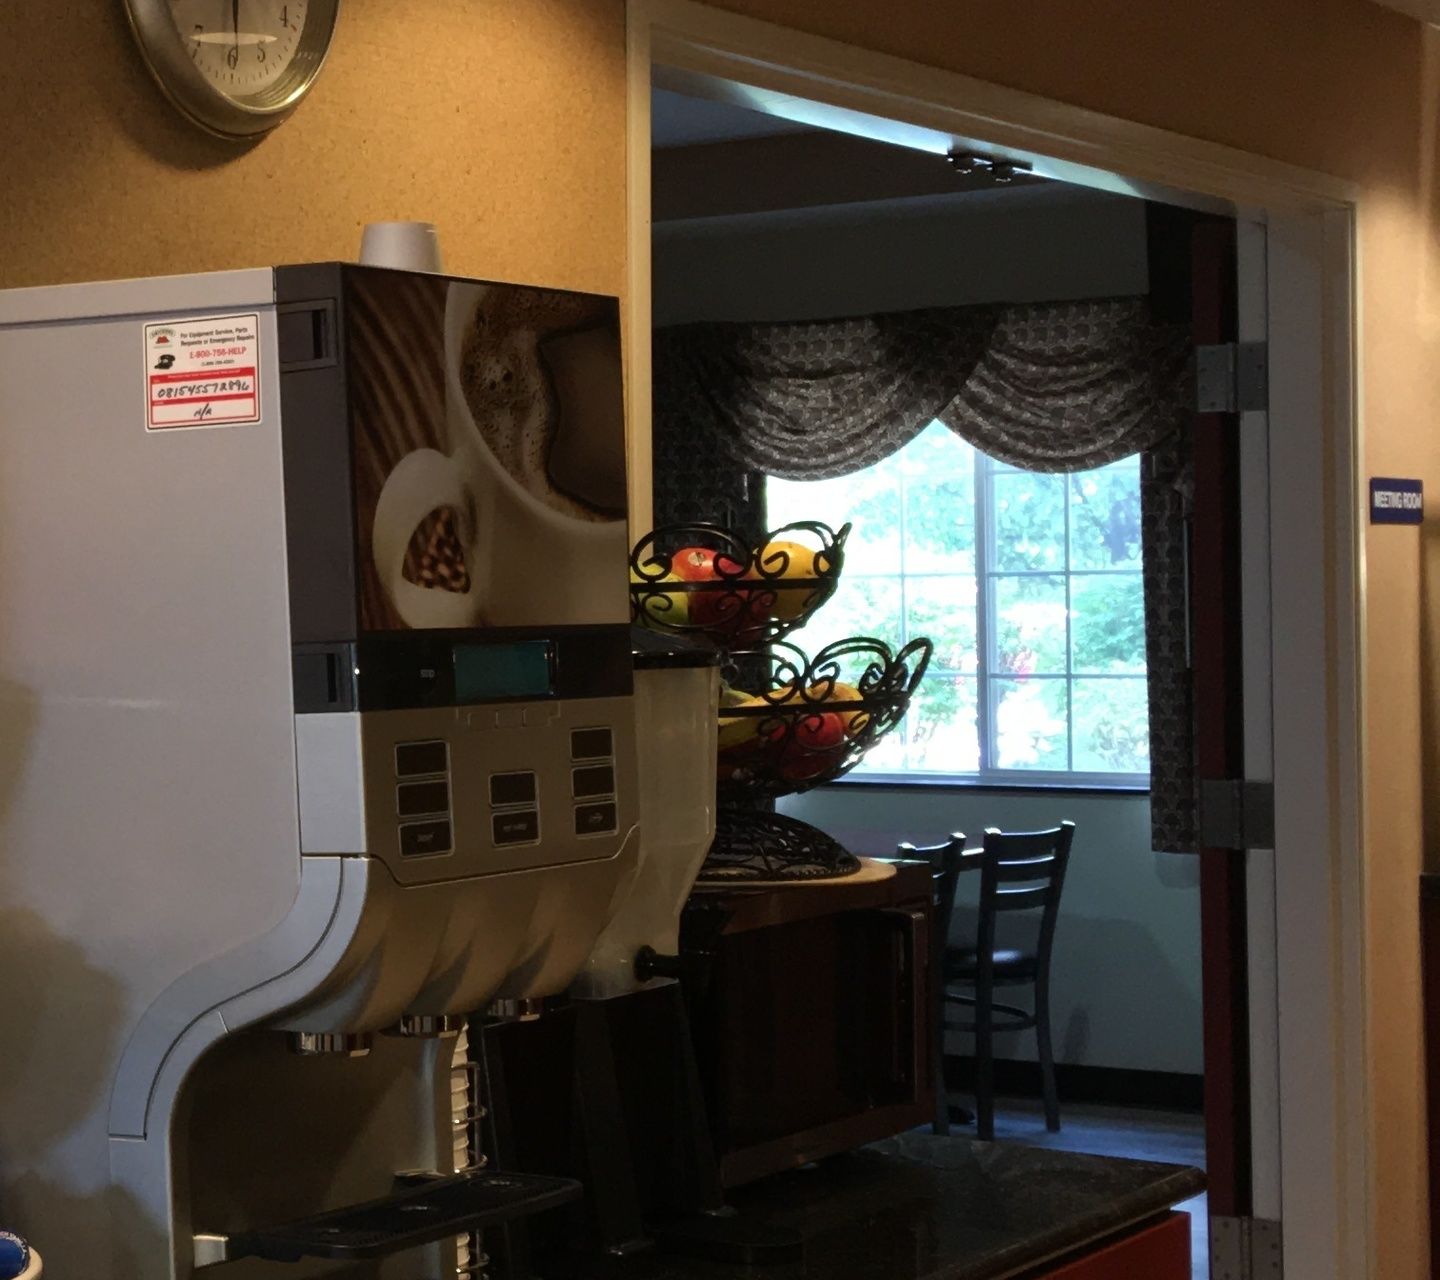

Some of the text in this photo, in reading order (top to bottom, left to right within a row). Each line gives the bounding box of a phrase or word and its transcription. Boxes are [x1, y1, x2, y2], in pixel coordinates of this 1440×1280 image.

[278, 5, 289, 28] 4
[194, 24, 205, 48] 7
[227, 46, 238, 70] 6
[256, 39, 266, 64] 5
[1374, 491, 1422, 509] MEETING ROOM
